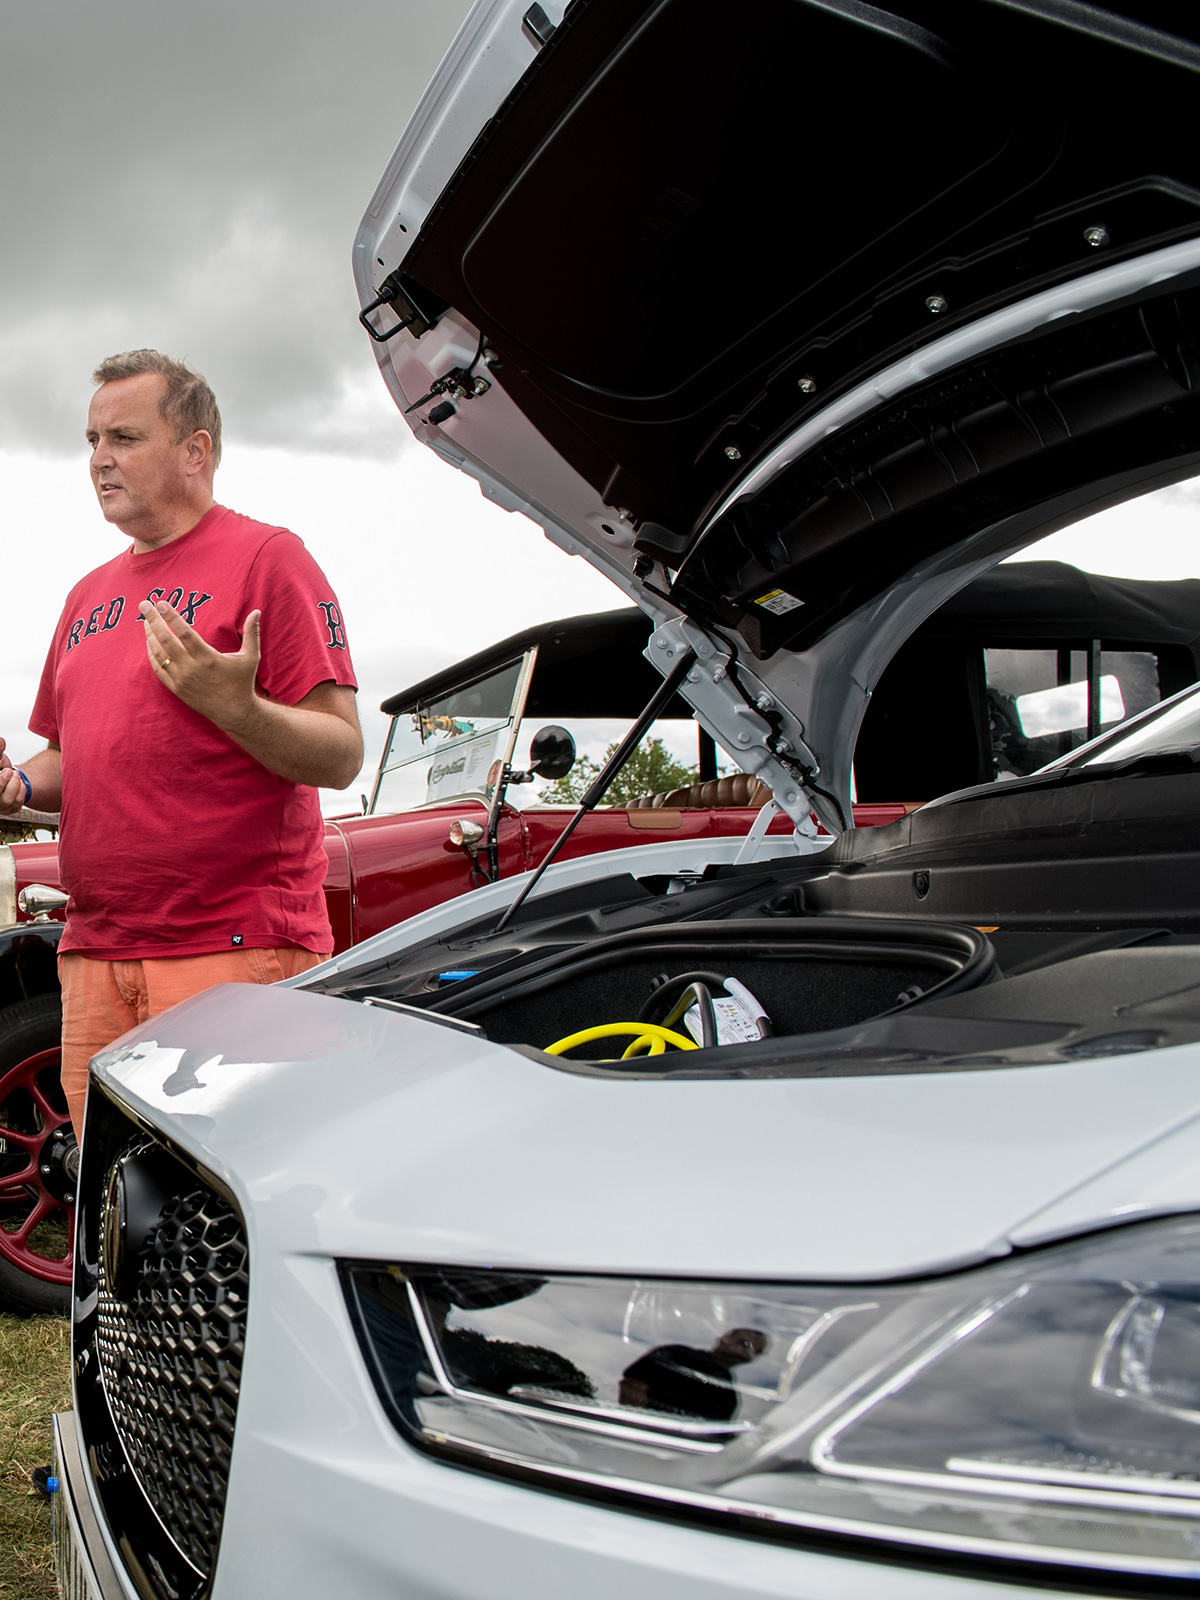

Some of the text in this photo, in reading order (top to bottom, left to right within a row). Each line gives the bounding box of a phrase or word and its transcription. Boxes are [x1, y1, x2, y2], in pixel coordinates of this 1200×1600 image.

[66, 587, 213, 654] RED SOX
[317, 601, 346, 650] B
